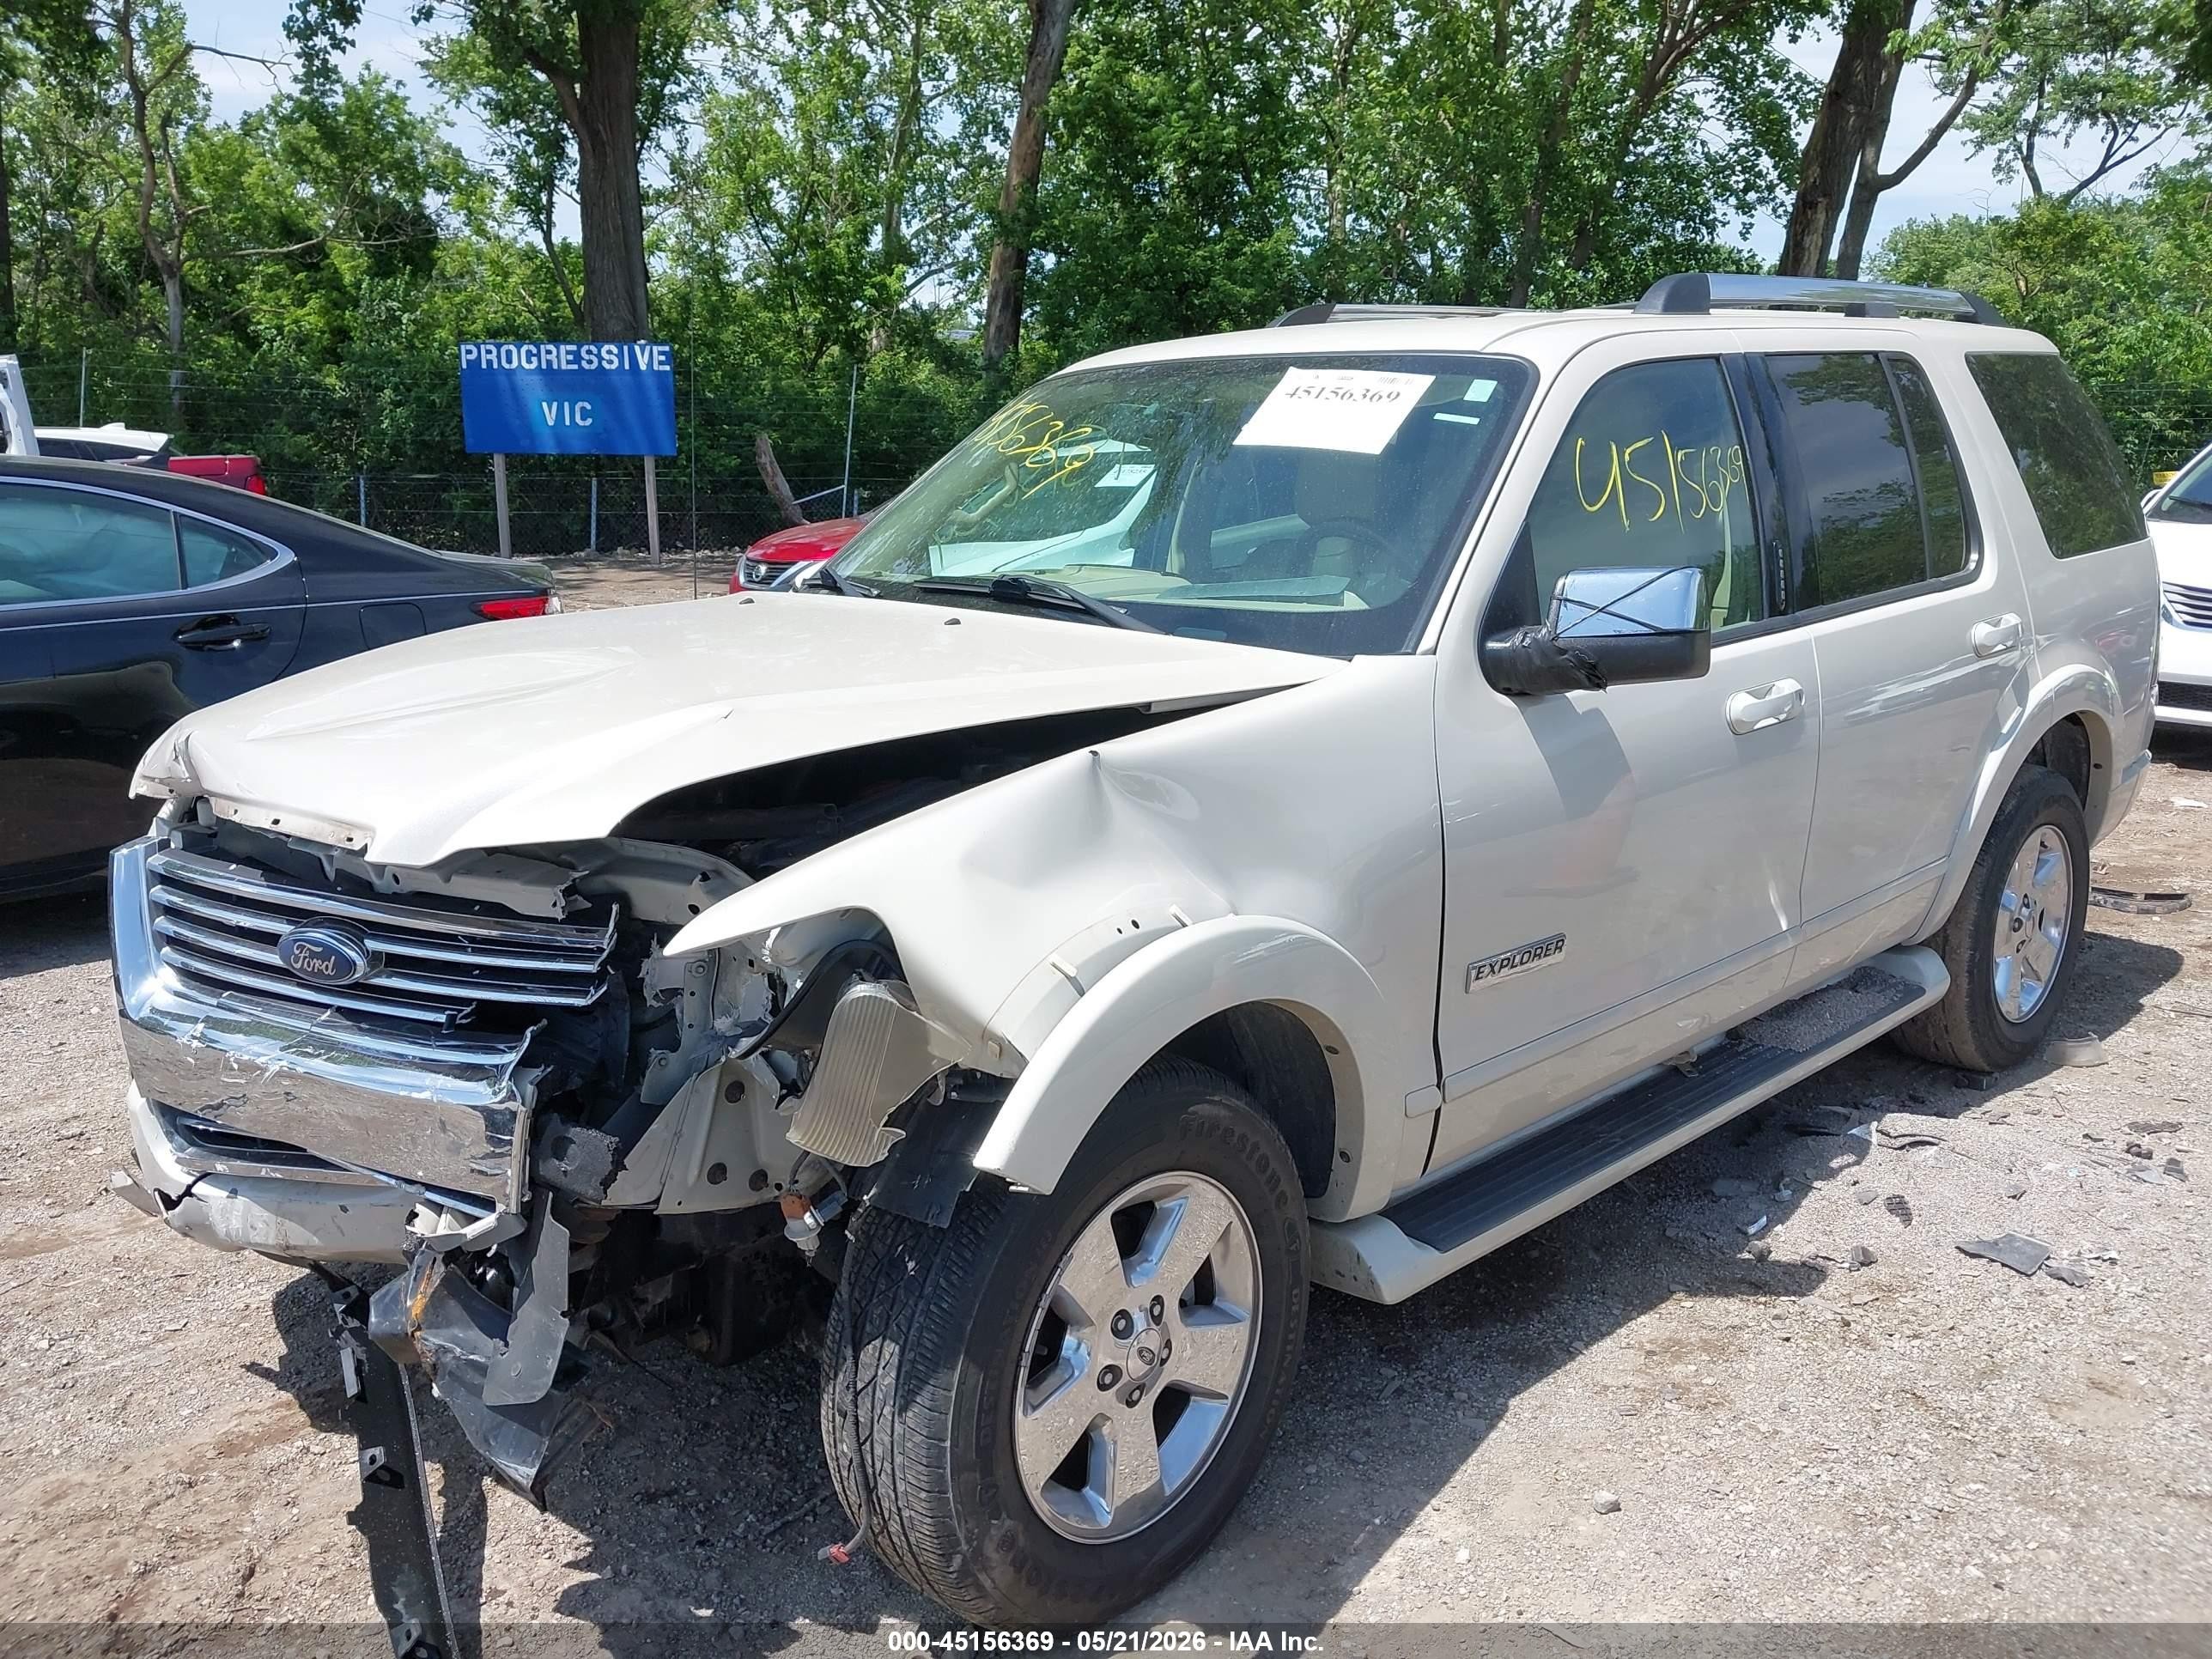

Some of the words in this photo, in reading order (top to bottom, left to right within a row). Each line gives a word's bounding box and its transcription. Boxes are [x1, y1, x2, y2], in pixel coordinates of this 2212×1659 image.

[460, 343, 670, 371] PROGRESSIVE
[1285, 386, 1401, 403] 45156369
[542, 401, 592, 426] VIC
[290, 941, 337, 976] Ford
[1474, 938, 1565, 981] EXPLORER
[1177, 1113, 1290, 1211] Firestone
